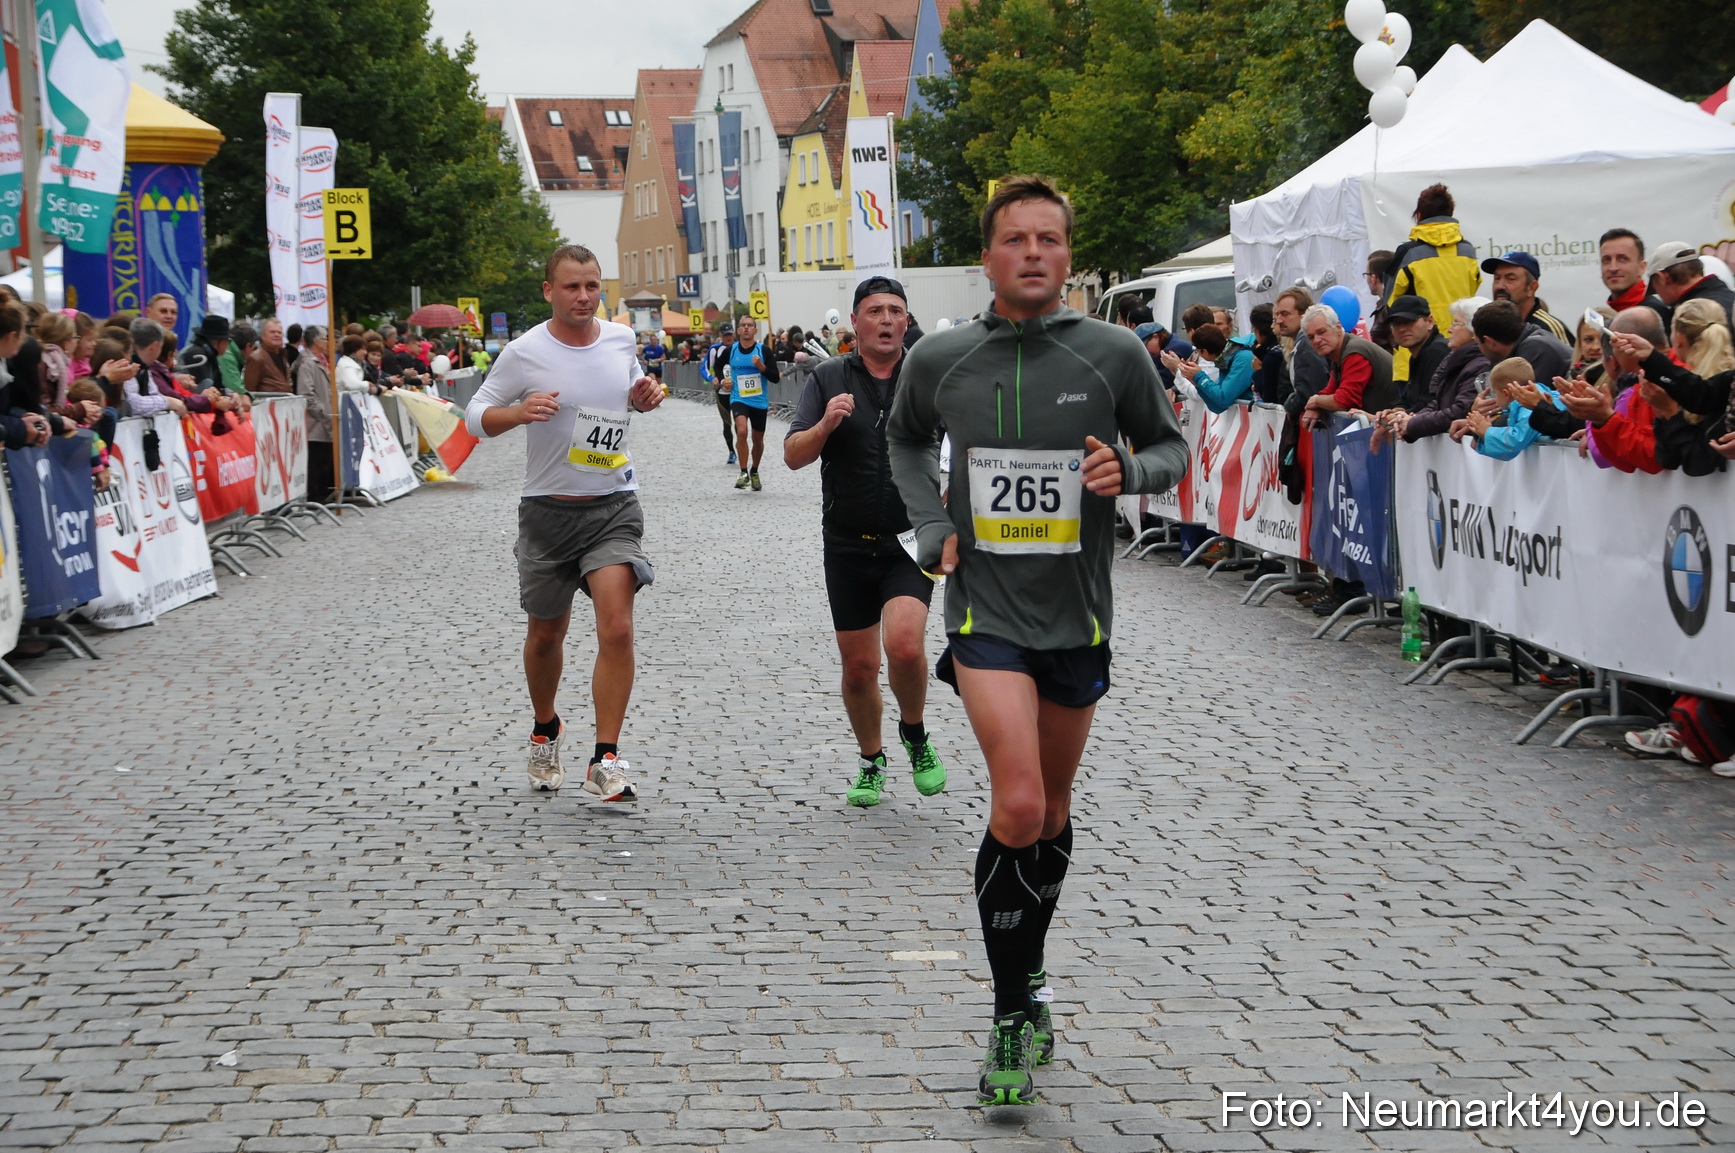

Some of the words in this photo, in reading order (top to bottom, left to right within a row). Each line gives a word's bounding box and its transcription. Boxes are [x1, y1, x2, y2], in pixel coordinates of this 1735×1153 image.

[327, 192, 364, 204] Block
[335, 210, 359, 243] B
[754, 300, 765, 315] C
[692, 315, 702, 327] D
[745, 379, 755, 389] 69
[1067, 392, 1087, 401] asics
[578, 412, 601, 423] PARTL
[586, 426, 624, 451] 442
[970, 457, 1006, 470] PARTL
[1009, 459, 1063, 471] Neumarkt
[990, 475, 1061, 513] 265
[1001, 523, 1049, 538] Daniel
